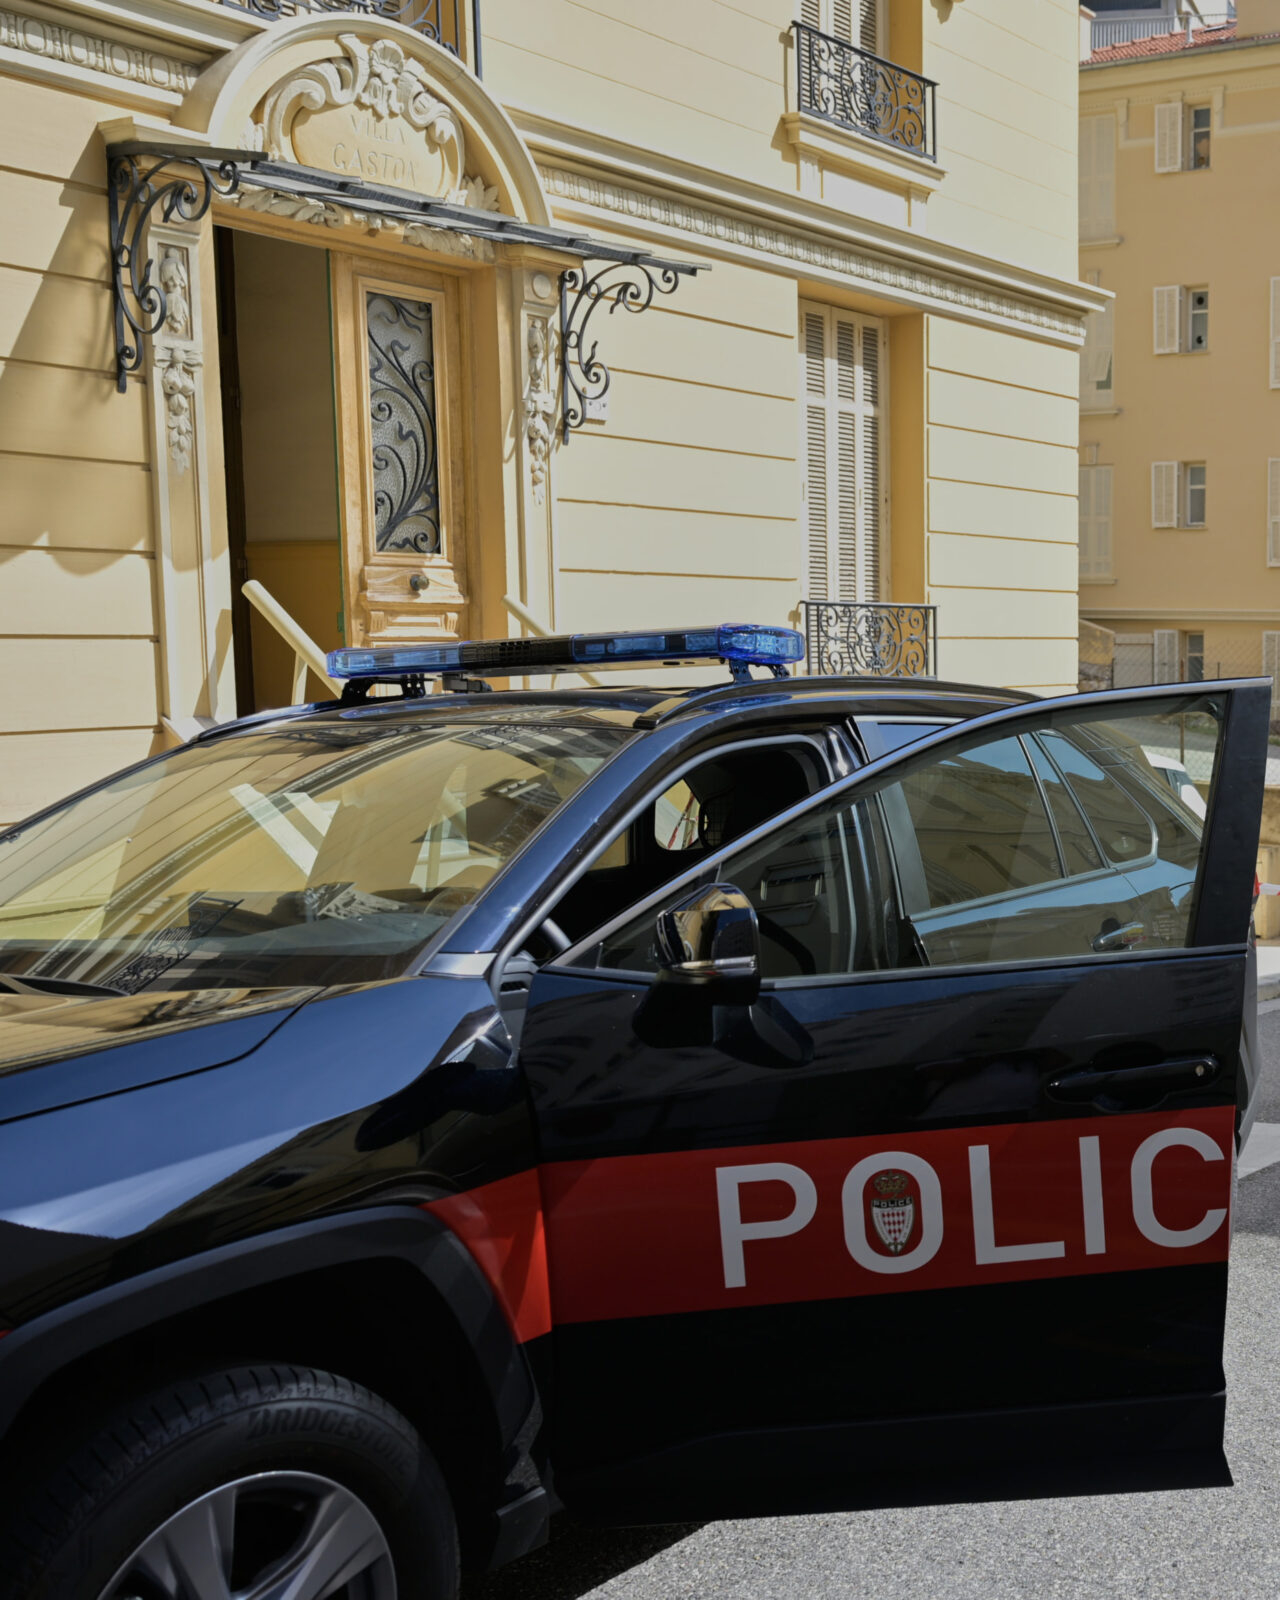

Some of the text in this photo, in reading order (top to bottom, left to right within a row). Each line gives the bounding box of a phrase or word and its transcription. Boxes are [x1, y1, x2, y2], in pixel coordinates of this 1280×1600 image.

[350, 114, 406, 145] VILLA
[332, 142, 417, 187] GASTON
[715, 1127, 1227, 1289] POLIC
[873, 1197, 912, 1208] POLICE
[247, 1406, 411, 1474] BRIDGESTONE
